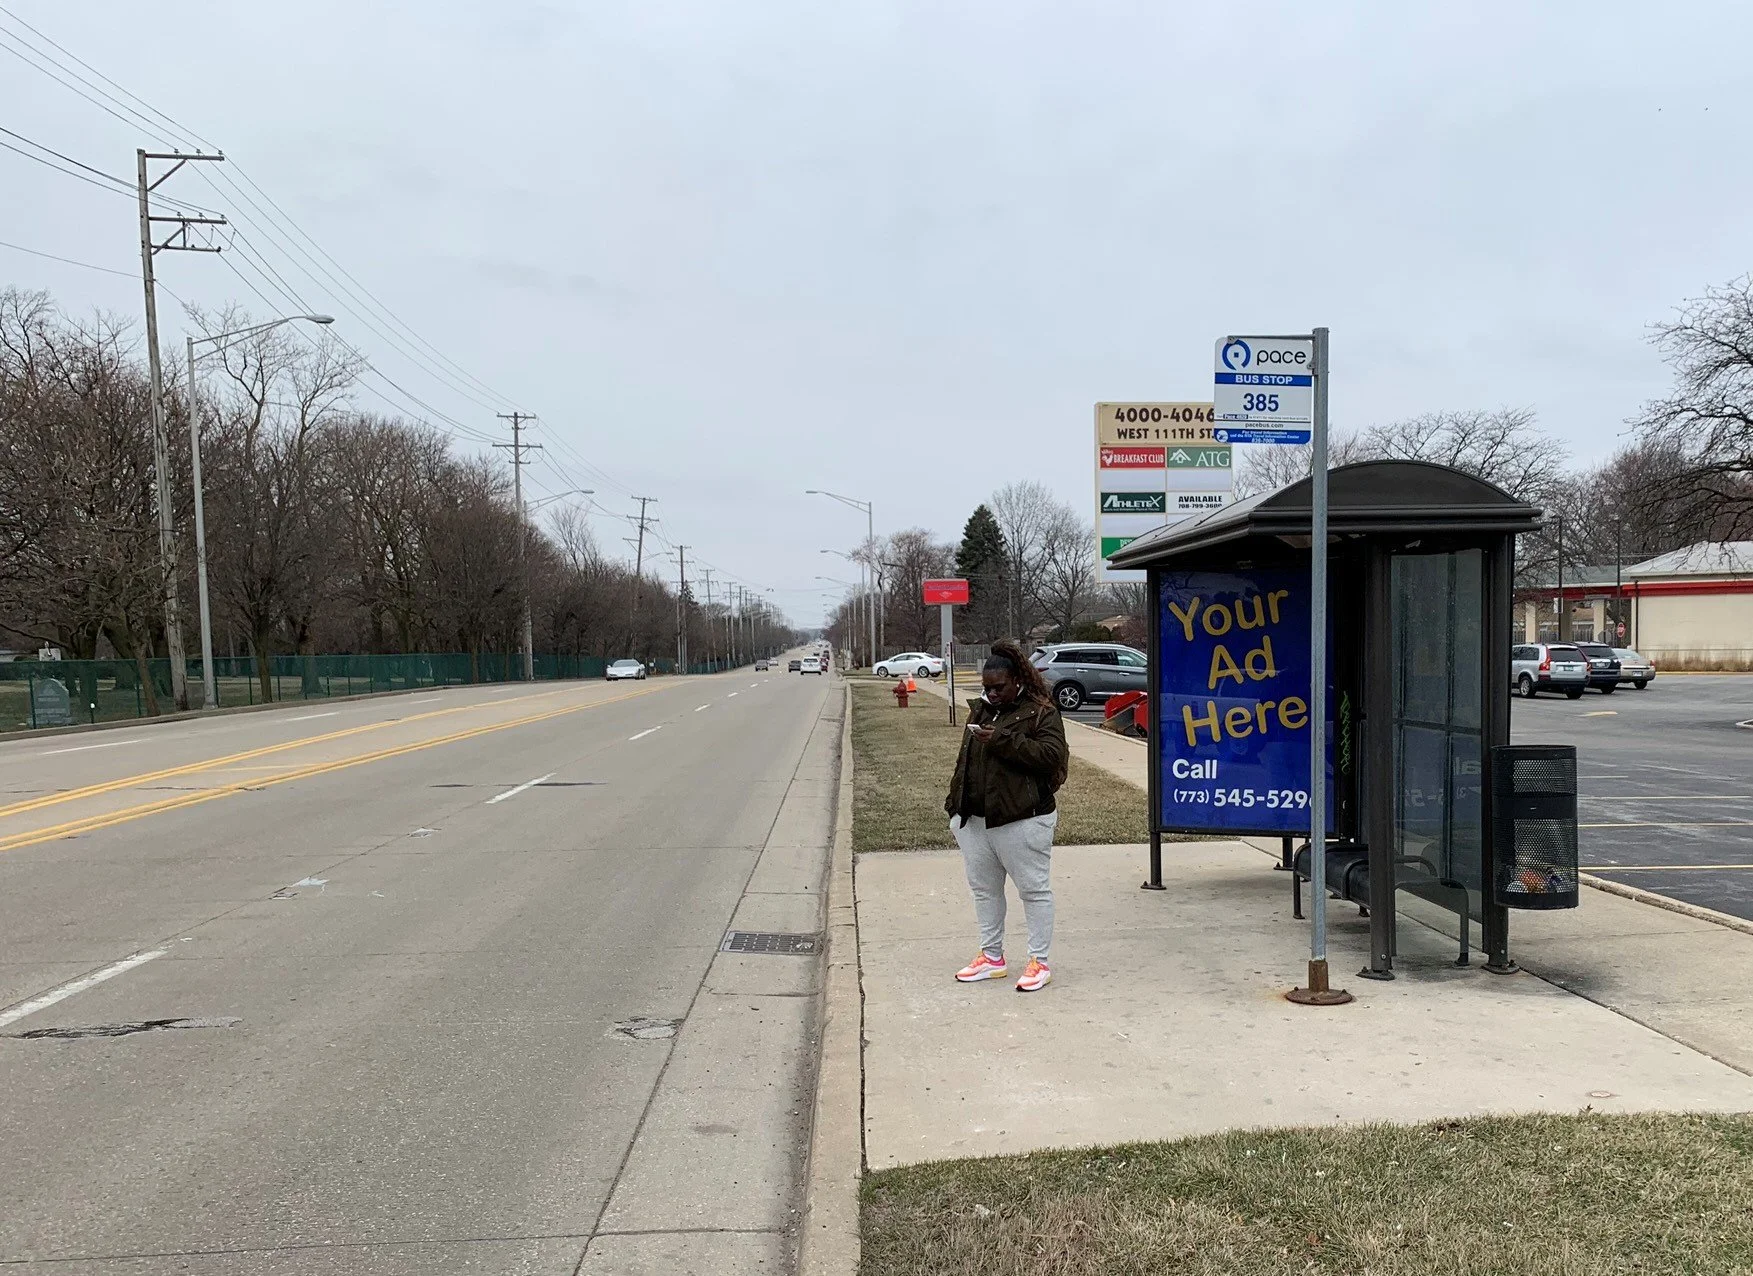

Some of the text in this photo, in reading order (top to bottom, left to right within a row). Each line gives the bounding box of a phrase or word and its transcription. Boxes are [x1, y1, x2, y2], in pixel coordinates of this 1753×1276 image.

[1256, 350, 1306, 366] pace
[1235, 375, 1293, 385] BUS STOP
[1243, 393, 1279, 412] 385
[1115, 407, 1214, 422] 4000-4046
[1245, 421, 1284, 429] pacebus.com
[1117, 428, 1149, 439] WEST
[1155, 428, 1194, 439] 111TH
[1113, 454, 1164, 463] BREAKFAST CLUB
[1196, 451, 1230, 467] ATG
[1168, 589, 1288, 641] Your
[1208, 635, 1275, 690] Ad
[1182, 696, 1309, 747] Here
[1172, 759, 1217, 779] Call
[1173, 788, 1312, 809] (773) 545-529
